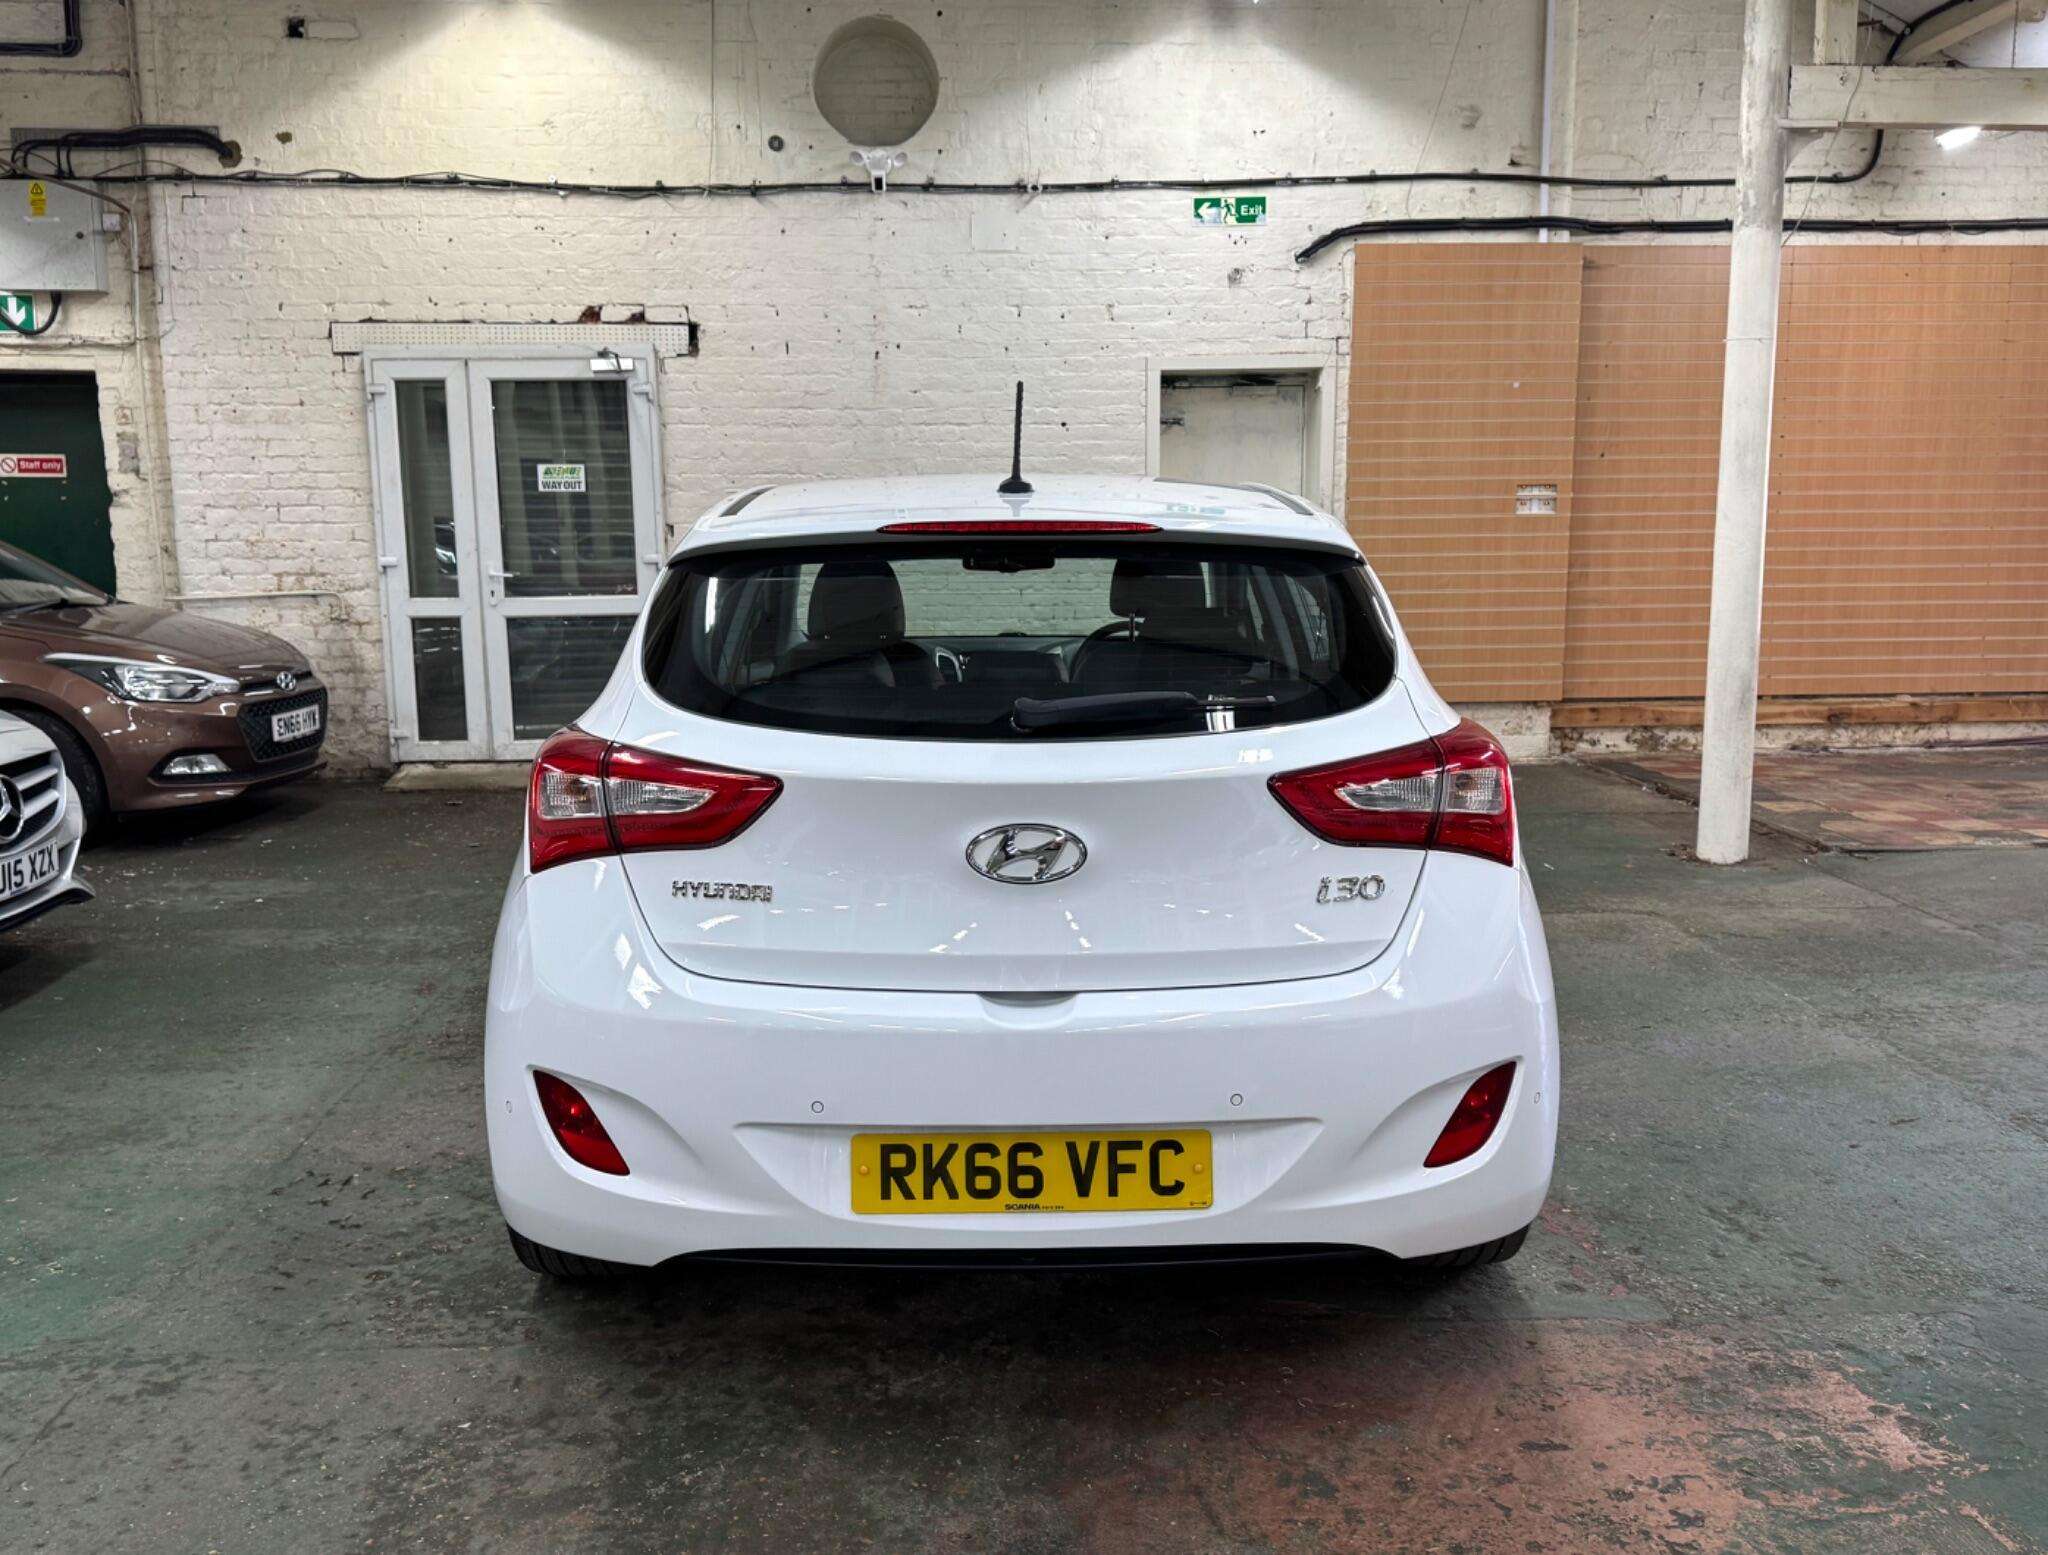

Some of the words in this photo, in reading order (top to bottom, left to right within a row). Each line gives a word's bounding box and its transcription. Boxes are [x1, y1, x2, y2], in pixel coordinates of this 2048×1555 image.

[1241, 204, 1263, 215] Exit
[20, 460, 40, 469] Staff
[42, 461, 60, 471] only
[541, 480, 562, 490] WAY
[563, 480, 582, 490] OUT
[28, 844, 55, 883] XZX
[671, 880, 773, 902] HYUNDAI
[880, 1142, 1044, 1200] RK66
[1065, 1139, 1186, 1198] VFC
